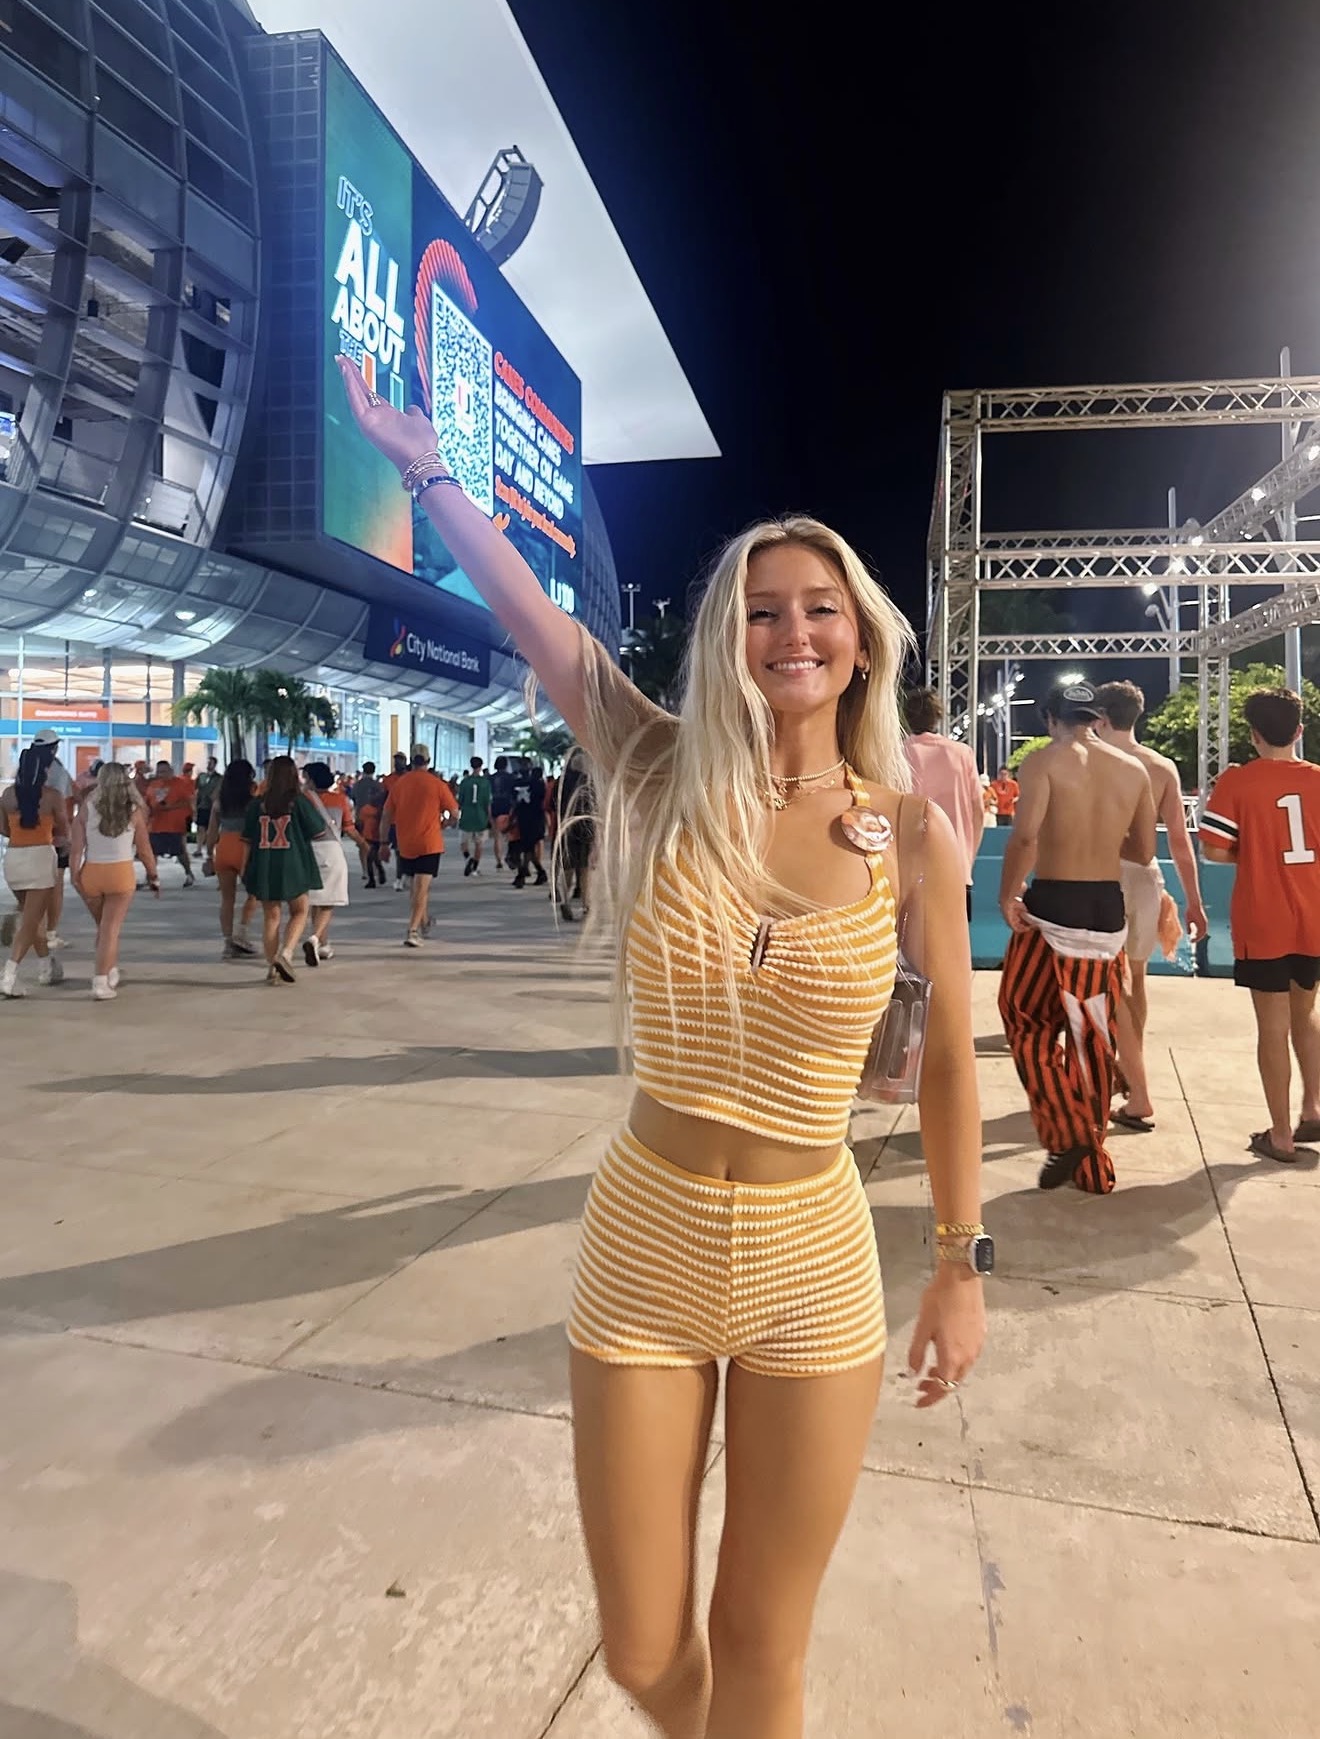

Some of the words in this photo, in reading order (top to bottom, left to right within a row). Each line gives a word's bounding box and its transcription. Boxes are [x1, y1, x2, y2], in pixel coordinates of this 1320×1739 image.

[336, 175, 374, 236] IT'S
[333, 218, 405, 337] ALL
[330, 285, 406, 375] ABOUT
[494, 410, 540, 473] TOGETHER
[539, 457, 554, 485] ON
[552, 468, 574, 505] GAME
[494, 441, 516, 477] DAY
[513, 460, 534, 494] AND
[533, 476, 565, 520] BEYOND
[406, 632, 426, 662] City
[426, 639, 459, 667] National
[461, 650, 480, 673] Bank
[258, 815, 292, 849] IX
[1276, 793, 1316, 865] 1
